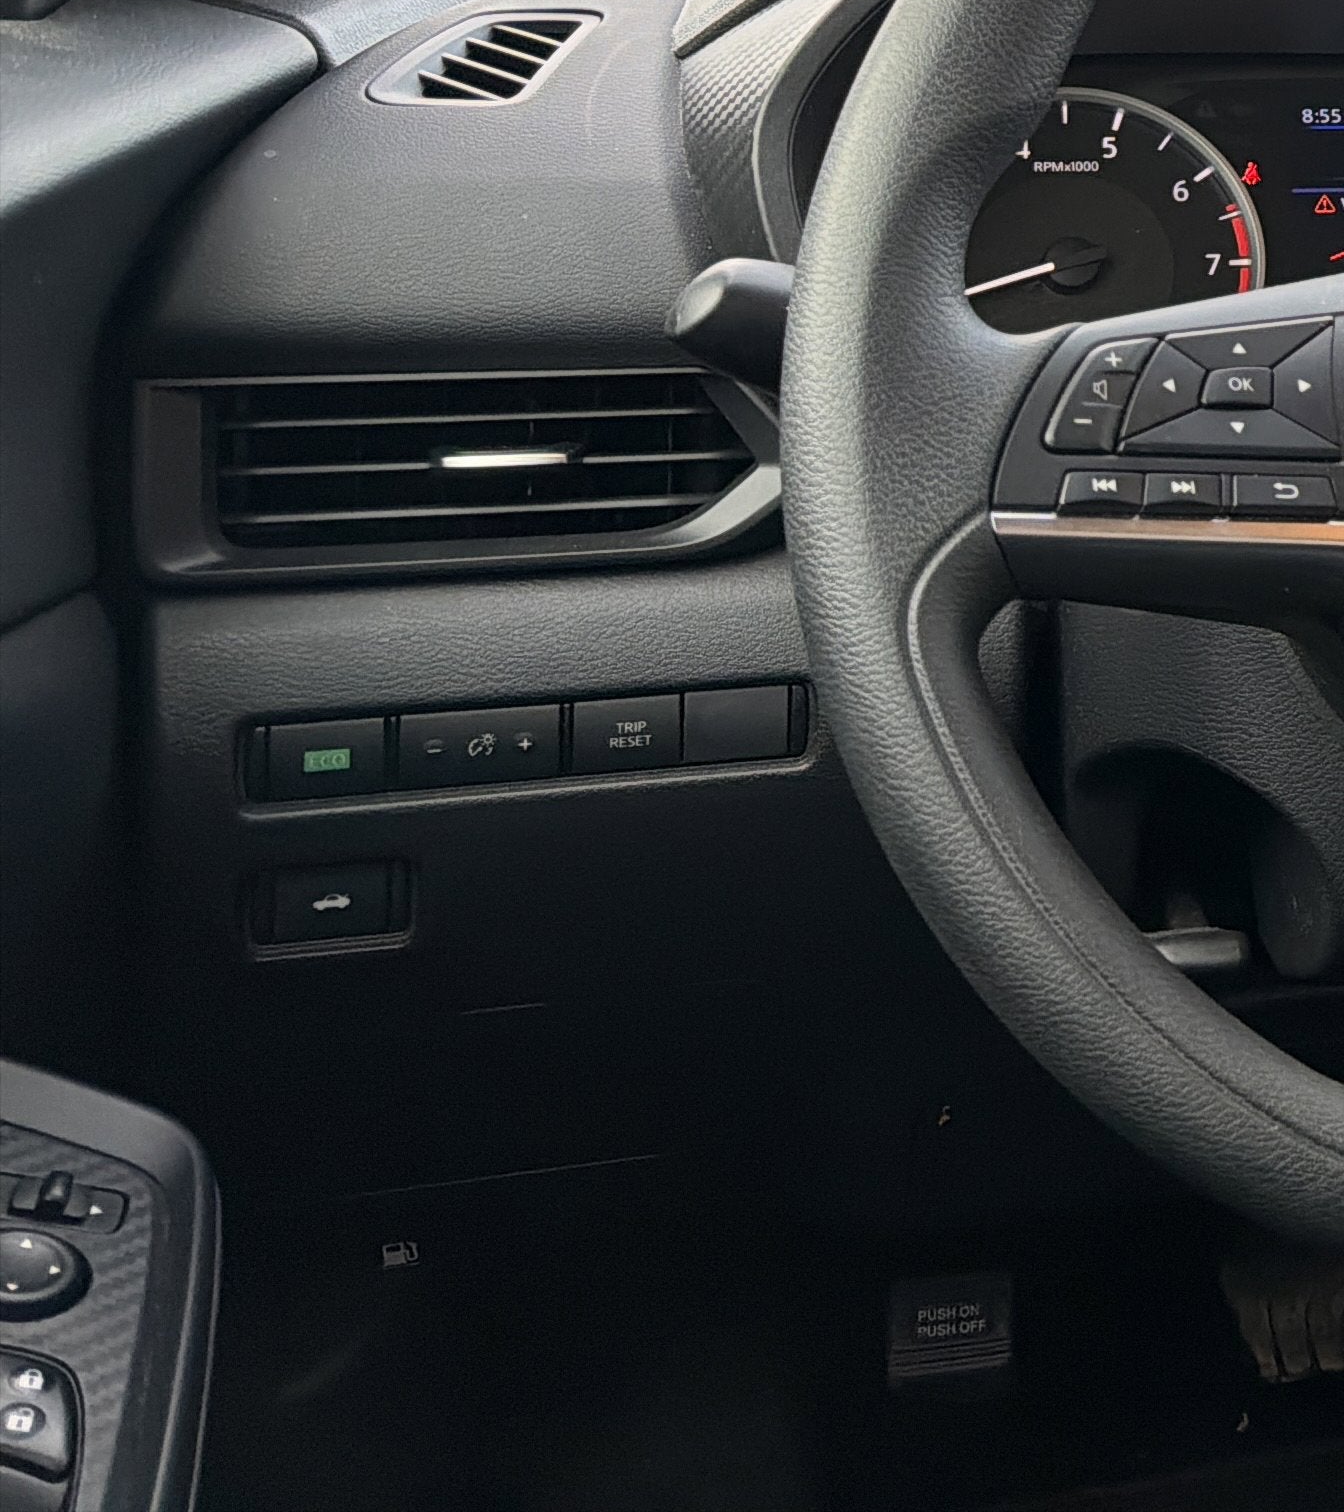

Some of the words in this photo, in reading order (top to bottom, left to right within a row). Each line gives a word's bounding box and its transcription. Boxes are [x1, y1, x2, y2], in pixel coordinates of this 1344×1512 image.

[1301, 108, 1342, 124] 8:55
[1034, 161, 1099, 173] RPMx1000
[1102, 137, 1118, 159] 5
[1172, 180, 1189, 202] 6
[1205, 254, 1221, 275] 7
[1227, 376, 1254, 393] OK
[616, 719, 648, 736] TRIP
[608, 734, 652, 749] RESET
[918, 1307, 957, 1321] PUSH
[960, 1304, 981, 1318] ON
[917, 1322, 957, 1337] PUSH
[959, 1319, 986, 1333] OFF
